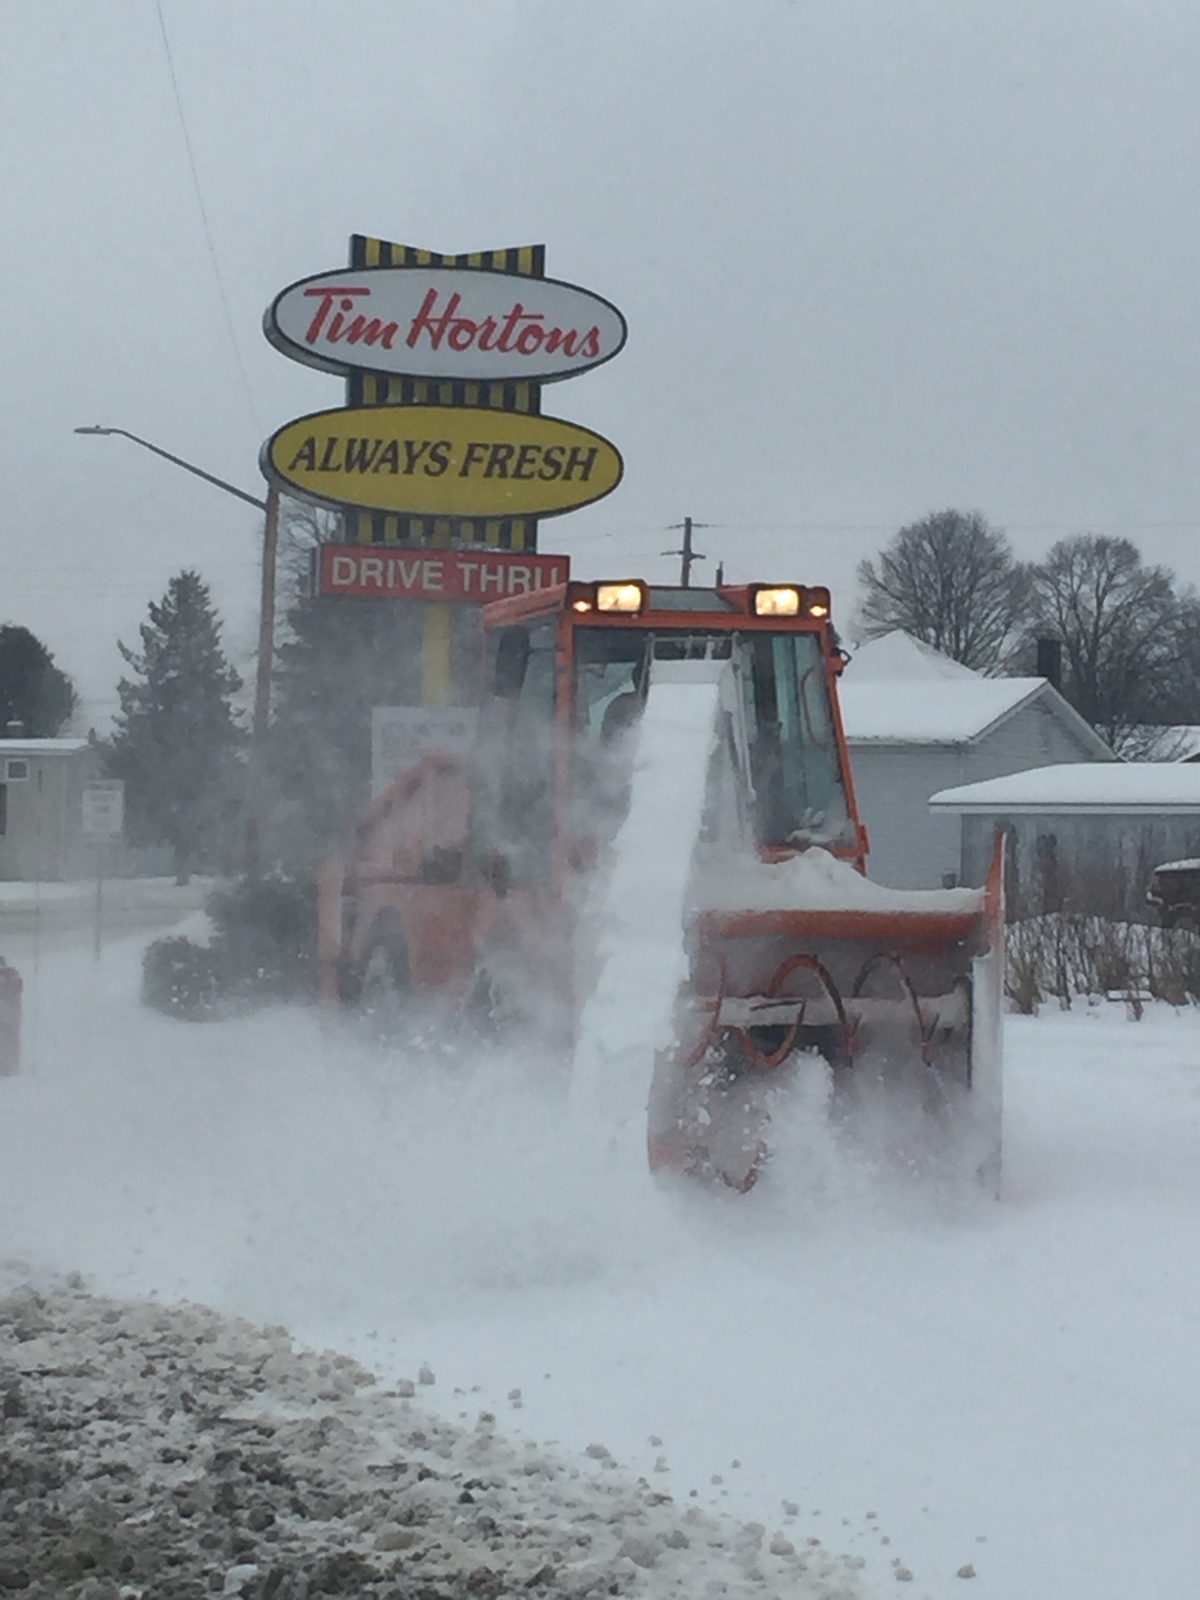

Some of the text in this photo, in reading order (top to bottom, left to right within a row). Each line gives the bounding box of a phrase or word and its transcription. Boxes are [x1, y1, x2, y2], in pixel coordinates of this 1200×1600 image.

[303, 287, 601, 358] Tim Hortons
[288, 436, 599, 481] ALWAYS FRESH
[331, 556, 558, 593] DRIVE THRU
